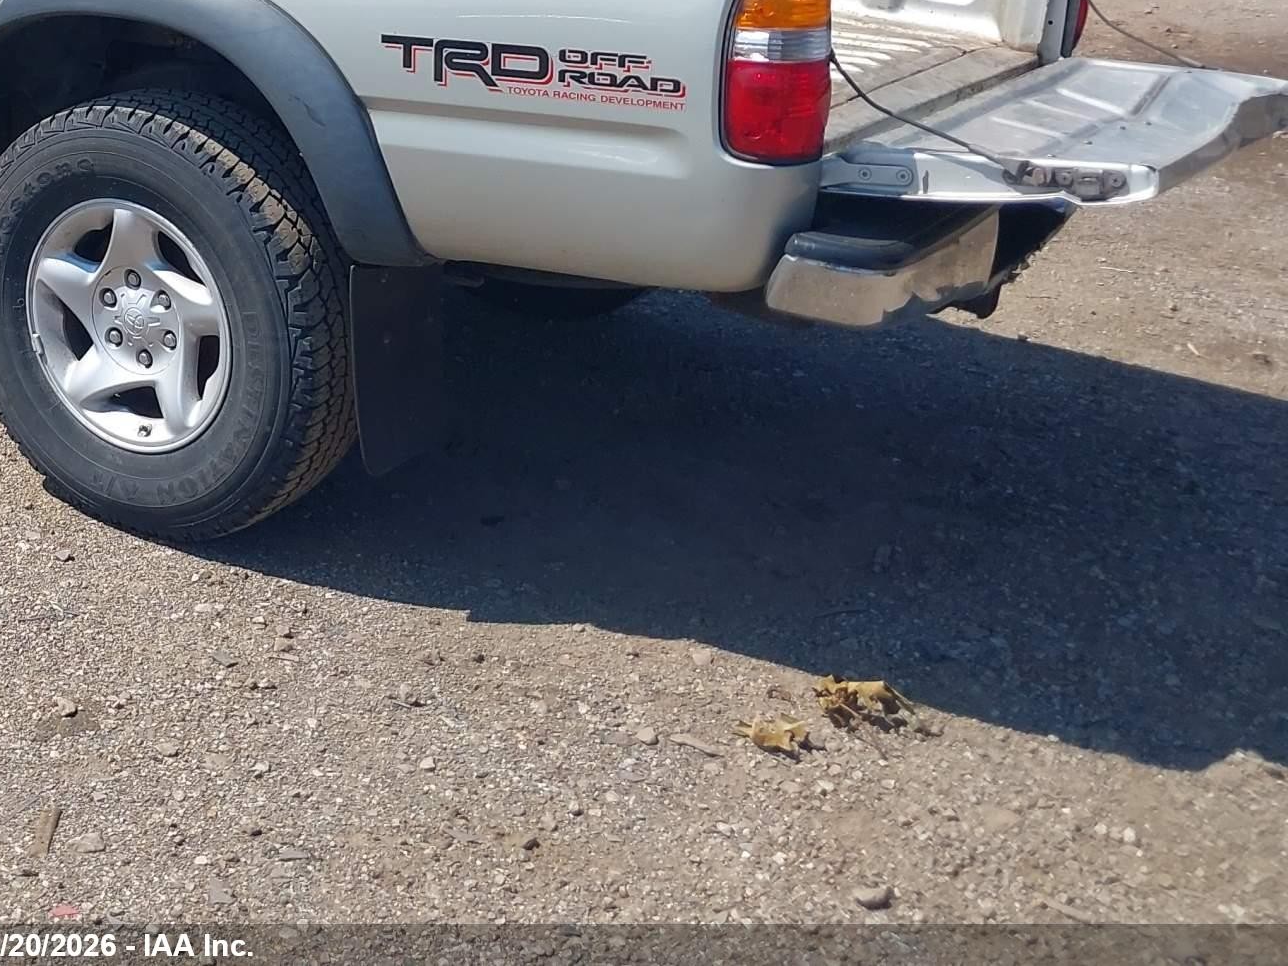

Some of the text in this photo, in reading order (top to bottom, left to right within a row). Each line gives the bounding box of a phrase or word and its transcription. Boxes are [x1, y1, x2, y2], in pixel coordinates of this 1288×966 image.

[381, 33, 553, 92] TRD
[558, 48, 652, 72] OFF
[558, 68, 686, 97] ROAD
[507, 86, 686, 111] TOYOTA RACING DEVELOPMENT
